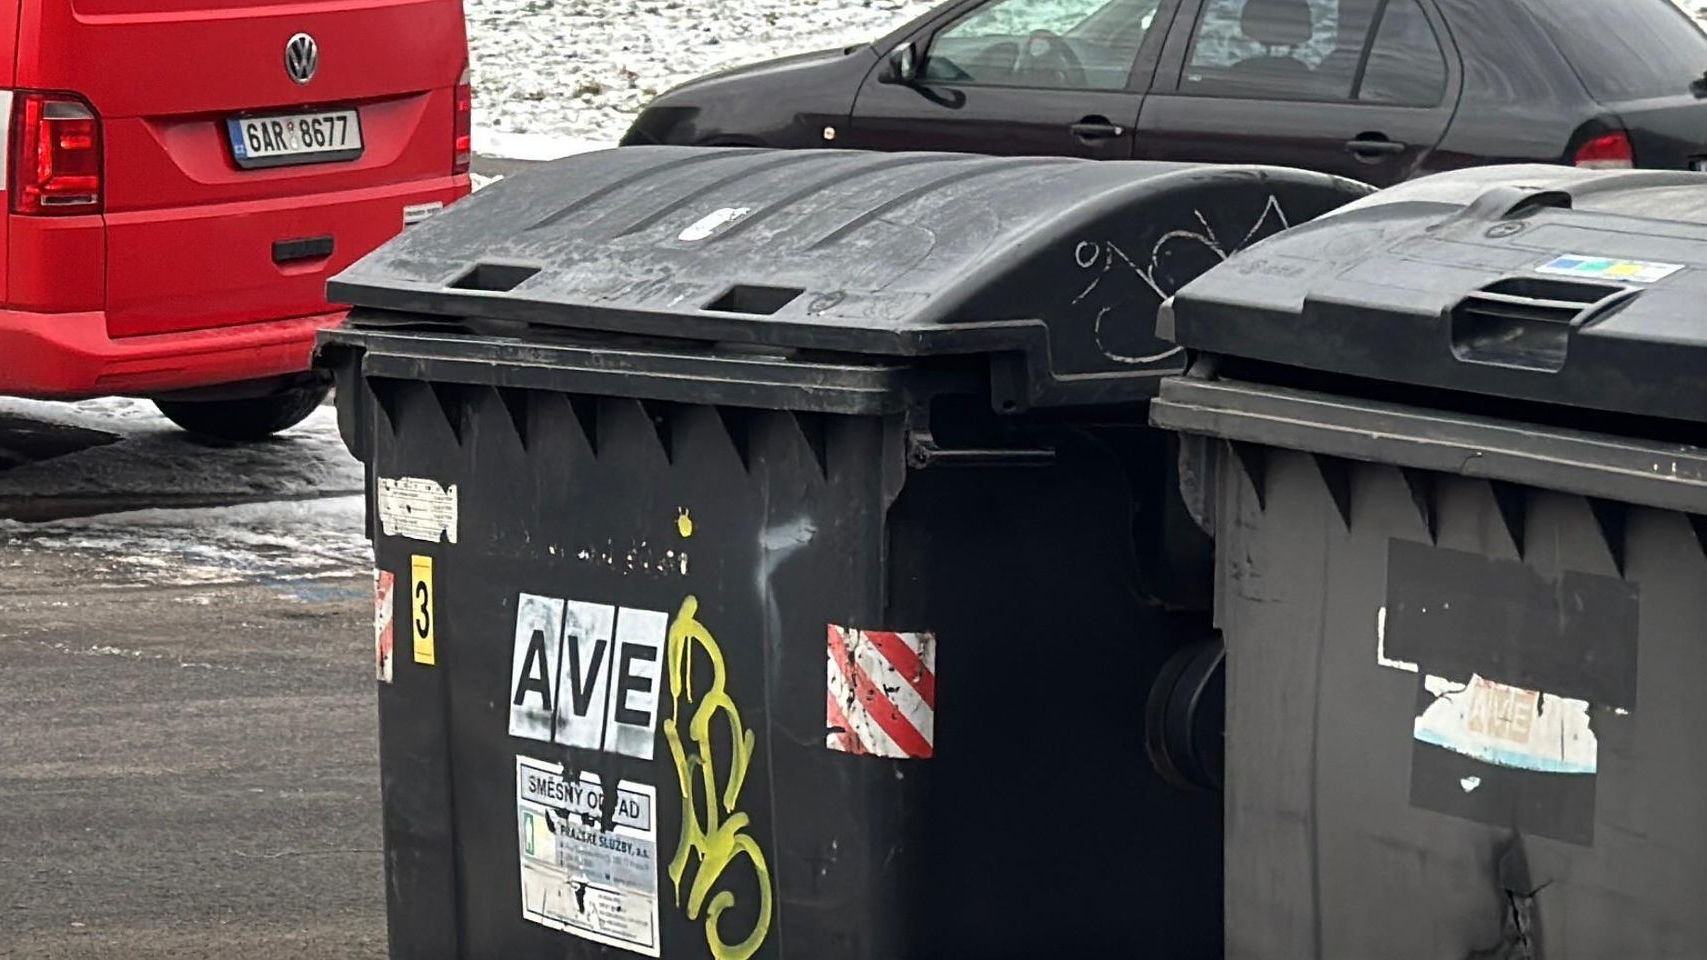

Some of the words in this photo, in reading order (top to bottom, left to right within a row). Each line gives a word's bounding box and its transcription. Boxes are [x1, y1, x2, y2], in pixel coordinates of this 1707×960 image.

[247, 120, 287, 152] 6AR
[299, 116, 347, 148] 8677
[416, 580, 430, 639] 3
[513, 629, 658, 728] AVE
